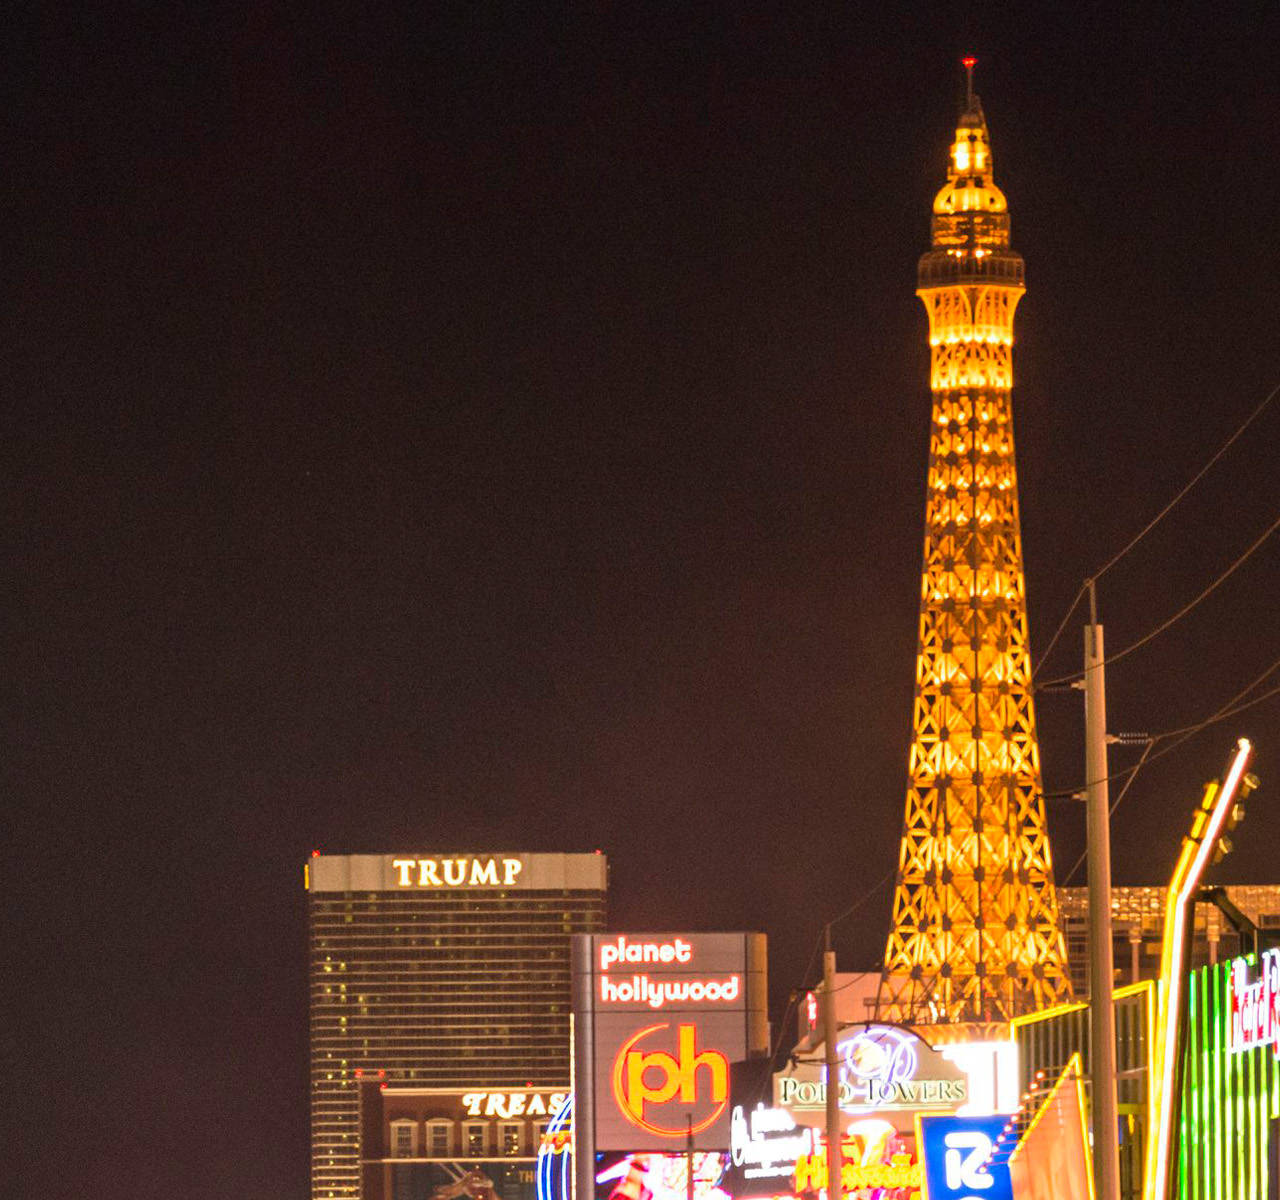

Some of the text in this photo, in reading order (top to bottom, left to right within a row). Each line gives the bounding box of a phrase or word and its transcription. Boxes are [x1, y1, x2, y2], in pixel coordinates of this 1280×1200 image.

[392, 858, 523, 887] TRUMP
[600, 937, 694, 970] planet
[600, 975, 739, 1009] hollywood
[625, 1022, 729, 1118] ph
